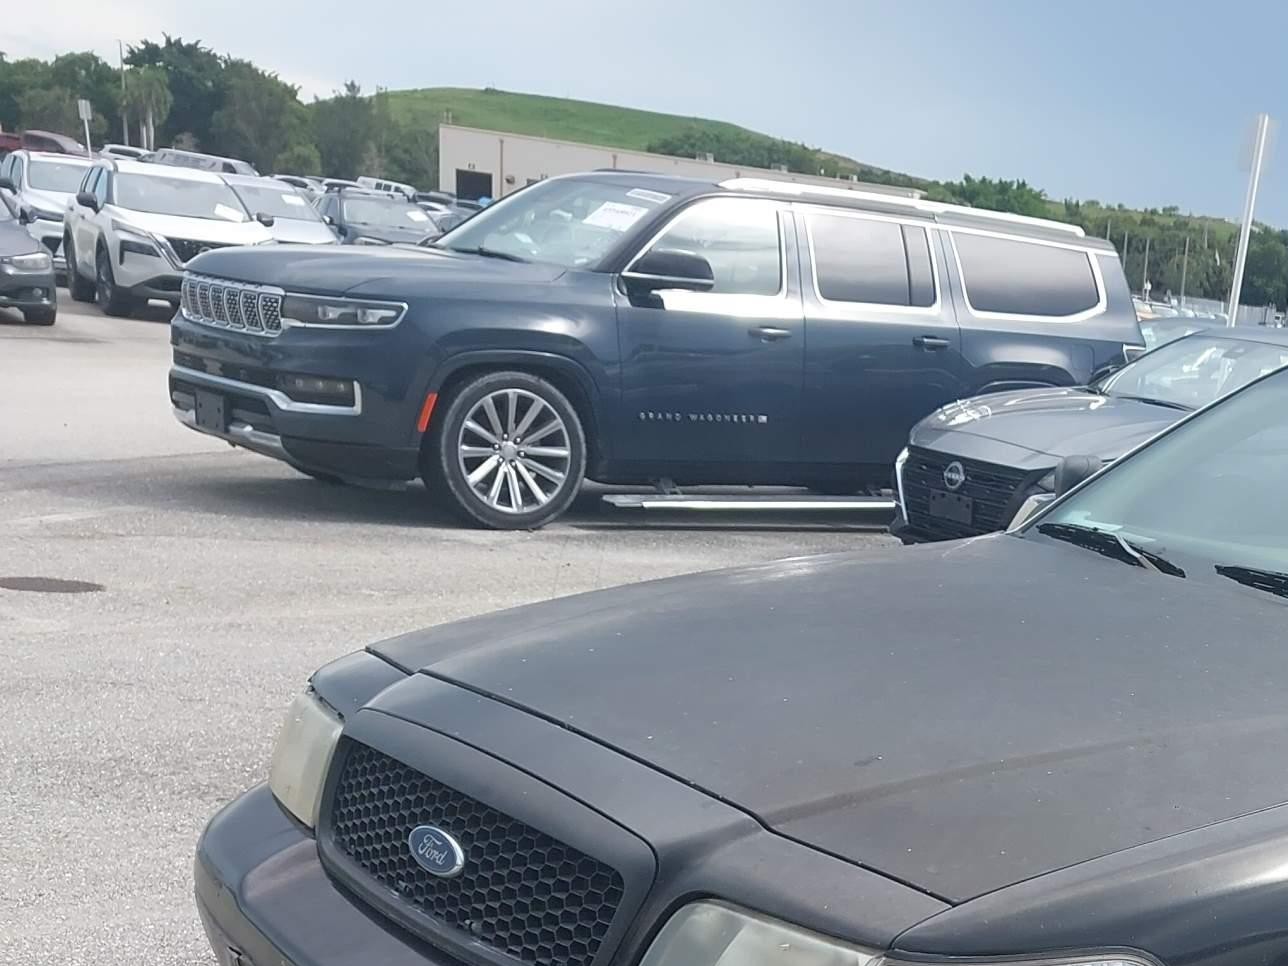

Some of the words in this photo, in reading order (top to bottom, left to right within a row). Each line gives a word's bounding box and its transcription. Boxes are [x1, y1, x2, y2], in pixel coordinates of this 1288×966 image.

[639, 411, 682, 422] GRAND
[688, 413, 755, 423] WAGONEER
[418, 834, 449, 866] Ford
